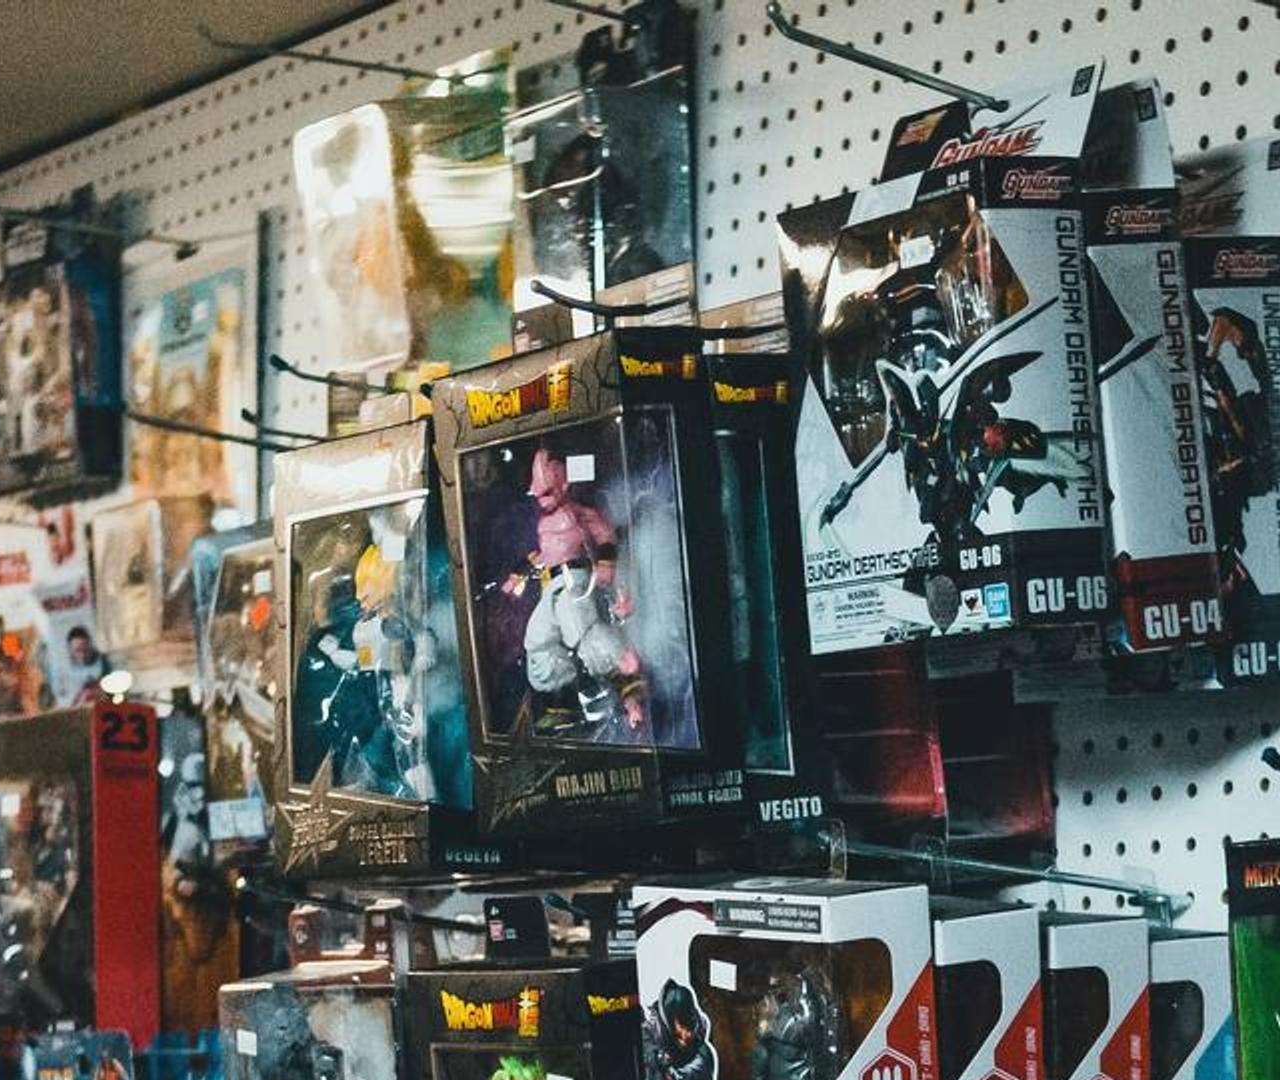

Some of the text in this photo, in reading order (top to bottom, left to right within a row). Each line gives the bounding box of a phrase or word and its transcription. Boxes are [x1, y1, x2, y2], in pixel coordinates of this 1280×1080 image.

[1055, 216, 1099, 522] GUNDAM DEATHSCYTHE
[1156, 249, 1208, 546] GUNDAM BARBATOS
[806, 561, 850, 584] GUNDAM
[960, 544, 1002, 571] GU-06
[1026, 575, 1108, 614] GU-06
[1143, 598, 1224, 640] GU-04
[102, 711, 149, 752] 23
[555, 770, 607, 799] MAJIN
[759, 796, 823, 822] VEGITO
